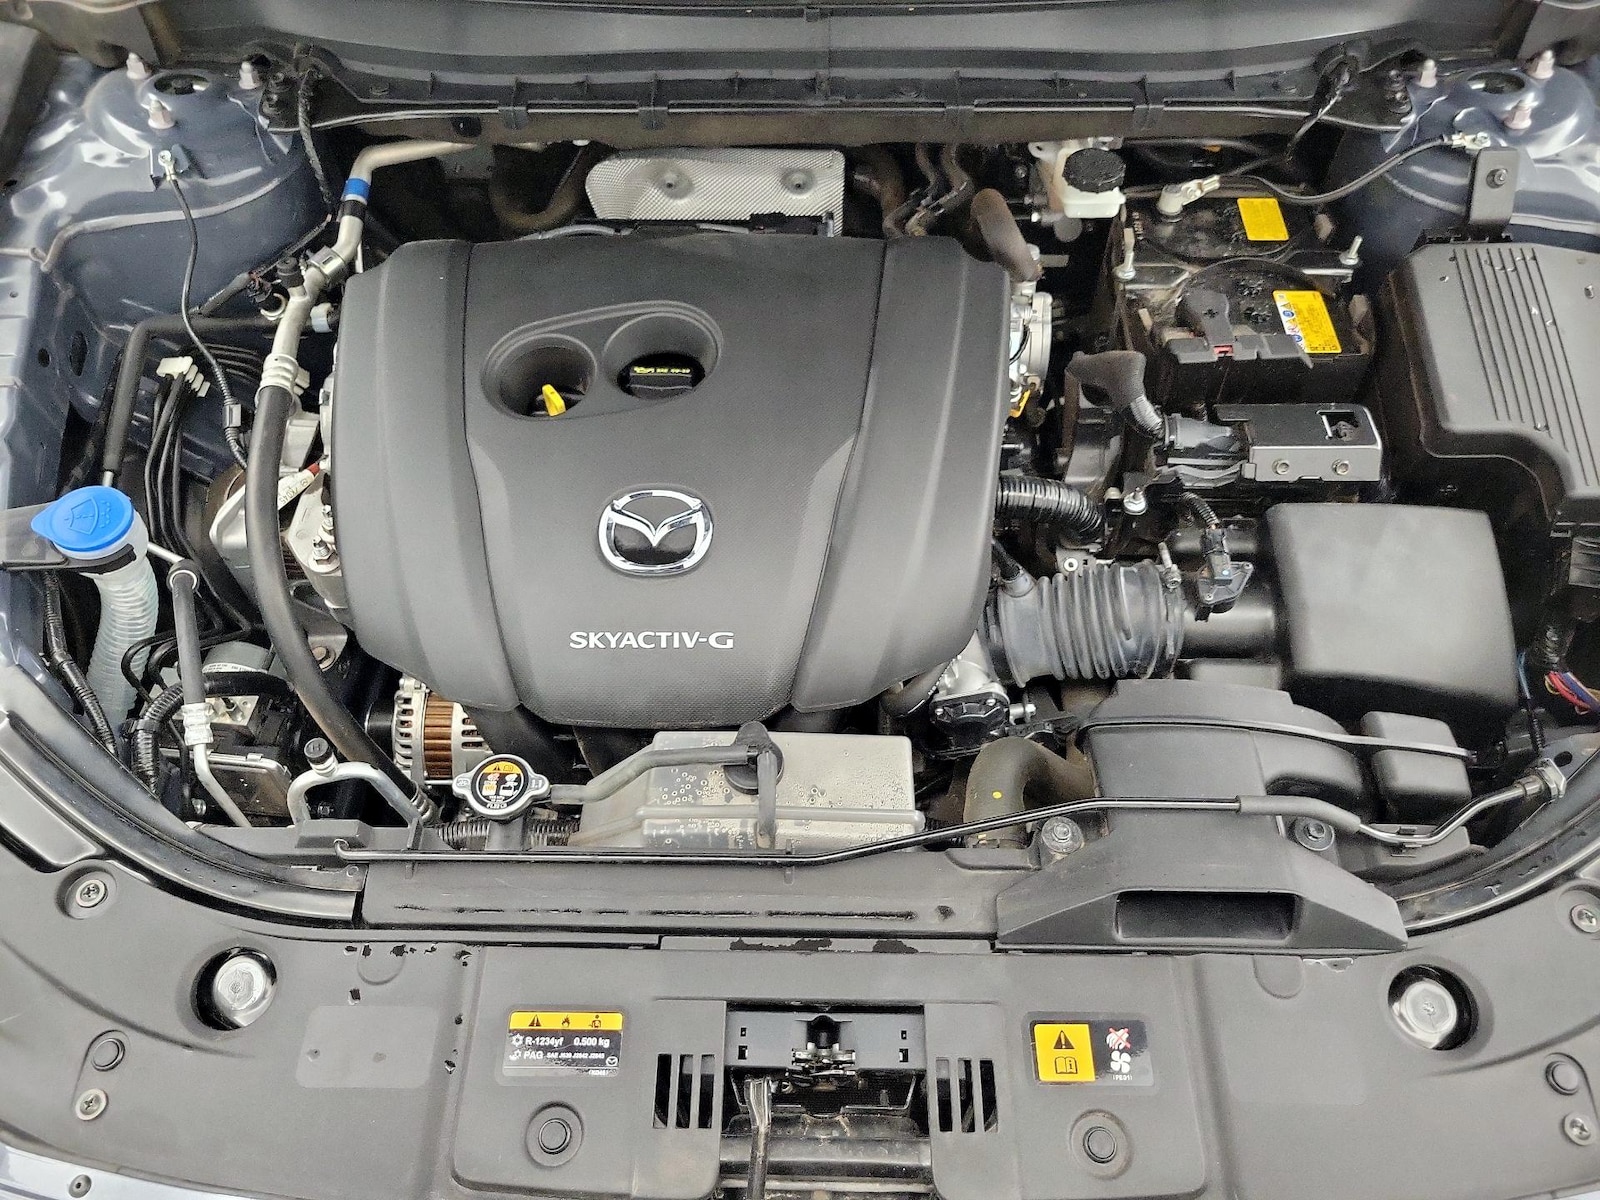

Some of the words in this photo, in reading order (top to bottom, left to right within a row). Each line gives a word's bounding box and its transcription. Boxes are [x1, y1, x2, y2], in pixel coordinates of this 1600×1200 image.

[569, 631, 735, 649] SKYACTIV-G
[525, 1036, 565, 1048] R-1234yf
[573, 1036, 598, 1047] 0.500
[598, 1037, 611, 1048] kg
[523, 1051, 545, 1060] PAG
